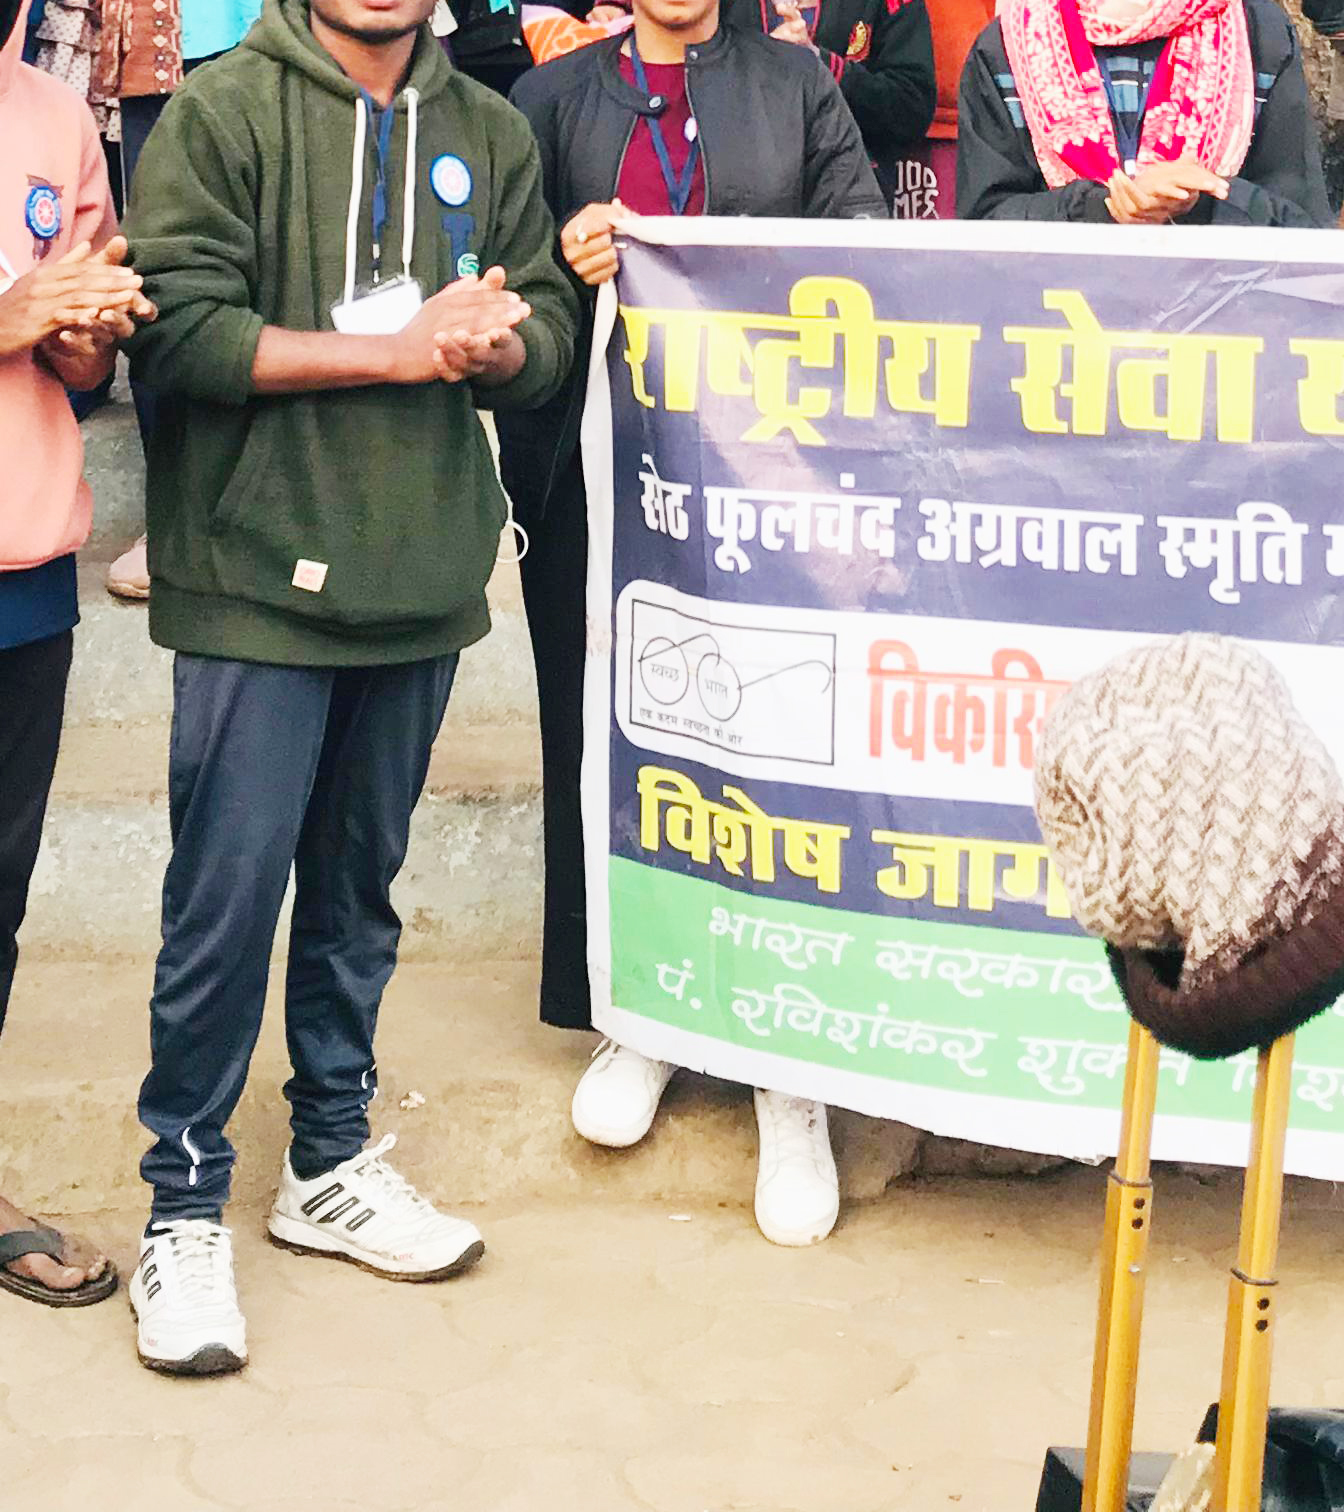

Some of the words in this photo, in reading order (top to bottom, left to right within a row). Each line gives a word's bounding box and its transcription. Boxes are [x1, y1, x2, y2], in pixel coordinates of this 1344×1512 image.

[619, 276, 980, 447] राष्ट्रीय
[1004, 291, 1263, 443] सेवा
[638, 454, 690, 543] सेठ
[704, 473, 901, 575] फूलचंद
[917, 497, 1140, 576] अग्रवाल
[1157, 502, 1305, 604] स्मृति
[867, 639, 1073, 770] विकसि
[637, 765, 851, 894] विशेष
[871, 829, 1072, 919] जाग
[656, 958, 703, 1010] पं.
[731, 984, 999, 1077] रविशंकर
[709, 906, 855, 970] भारत
[875, 939, 1127, 1011] सरकार
